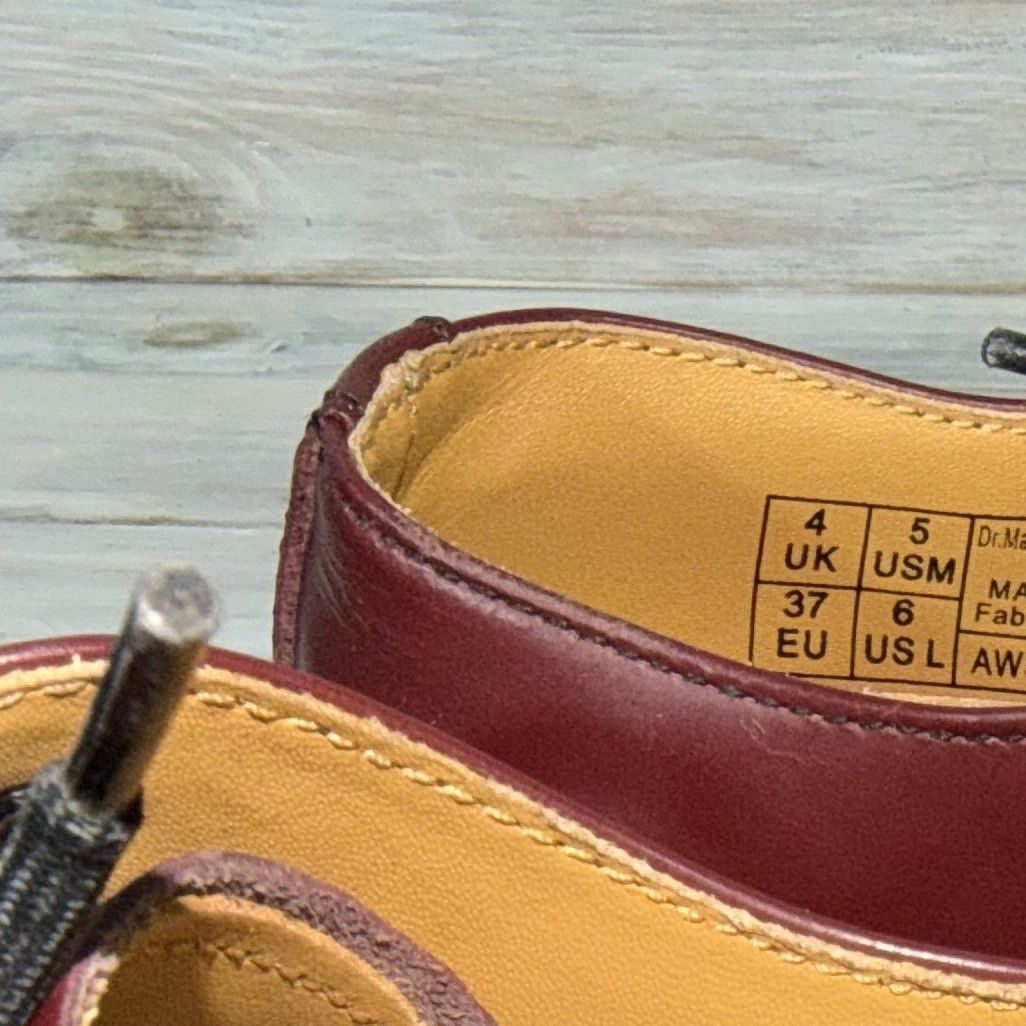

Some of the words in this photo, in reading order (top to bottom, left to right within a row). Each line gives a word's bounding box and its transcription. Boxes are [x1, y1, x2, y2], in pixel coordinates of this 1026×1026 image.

[804, 509, 827, 536] 4
[909, 517, 930, 545] 5
[784, 543, 840, 573] UK
[873, 550, 956, 585] USM
[783, 589, 829, 619] 37
[892, 599, 915, 626] 6
[777, 627, 827, 660] EU
[865, 633, 915, 666] US
